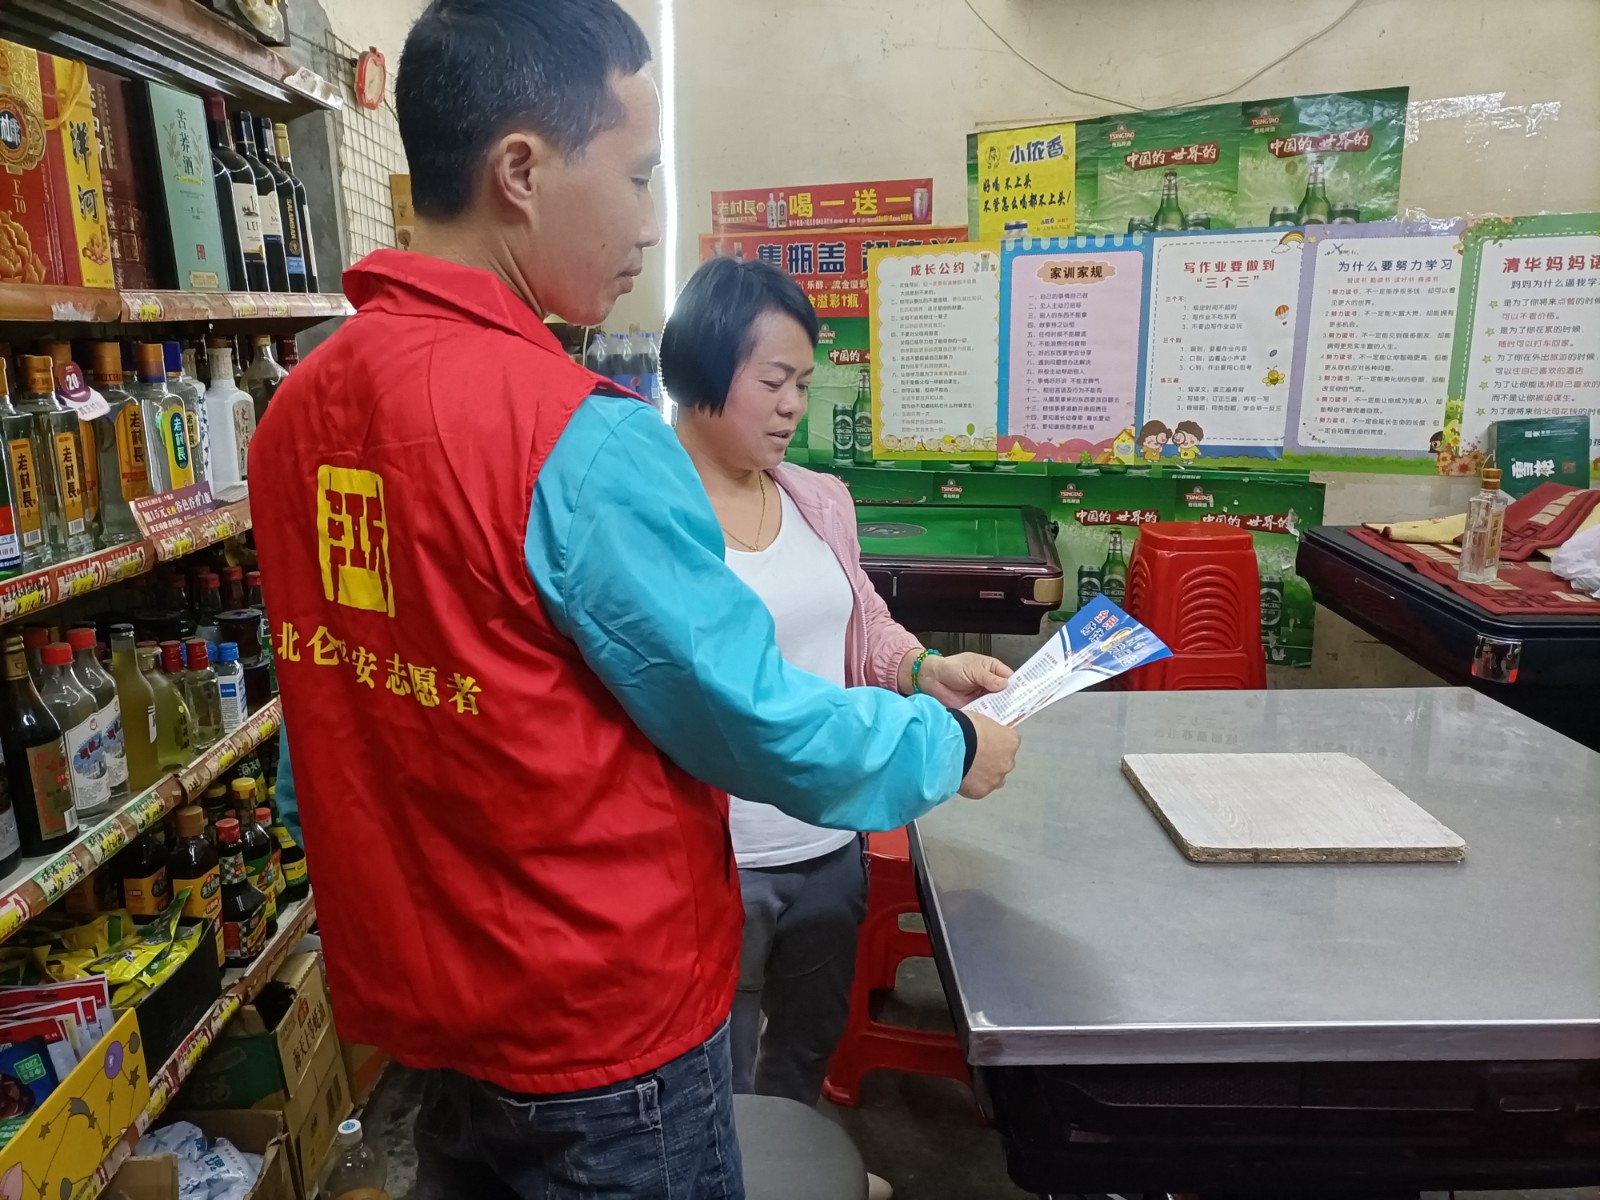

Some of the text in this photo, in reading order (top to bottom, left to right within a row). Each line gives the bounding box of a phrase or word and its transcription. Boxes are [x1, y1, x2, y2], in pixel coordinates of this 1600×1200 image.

[1270, 131, 1370, 156] 中国的 世界的
[1127, 145, 1216, 169] 中国的 世界的
[13, 179, 21, 195] F
[789, 188, 912, 218] 喝一送一
[911, 262, 965, 276] 成长公约
[1050, 266, 1103, 279] 家训家规
[1184, 259, 1275, 273] 写作业要做到
[1338, 259, 1453, 272] 为什么要努力学习
[1511, 278, 1600, 289] 妈妈为什么逼我学
[830, 349, 860, 363] 中国的
[1493, 380, 1600, 390] 为了让你能选择自己喜欢的
[62, 445, 79, 498] 老村長
[17, 452, 34, 508] 老村長
[1076, 510, 1158, 524] 中国的 世界的
[1246, 515, 1290, 530] 世界的
[277, 622, 482, 715] 北仑安志愿者
